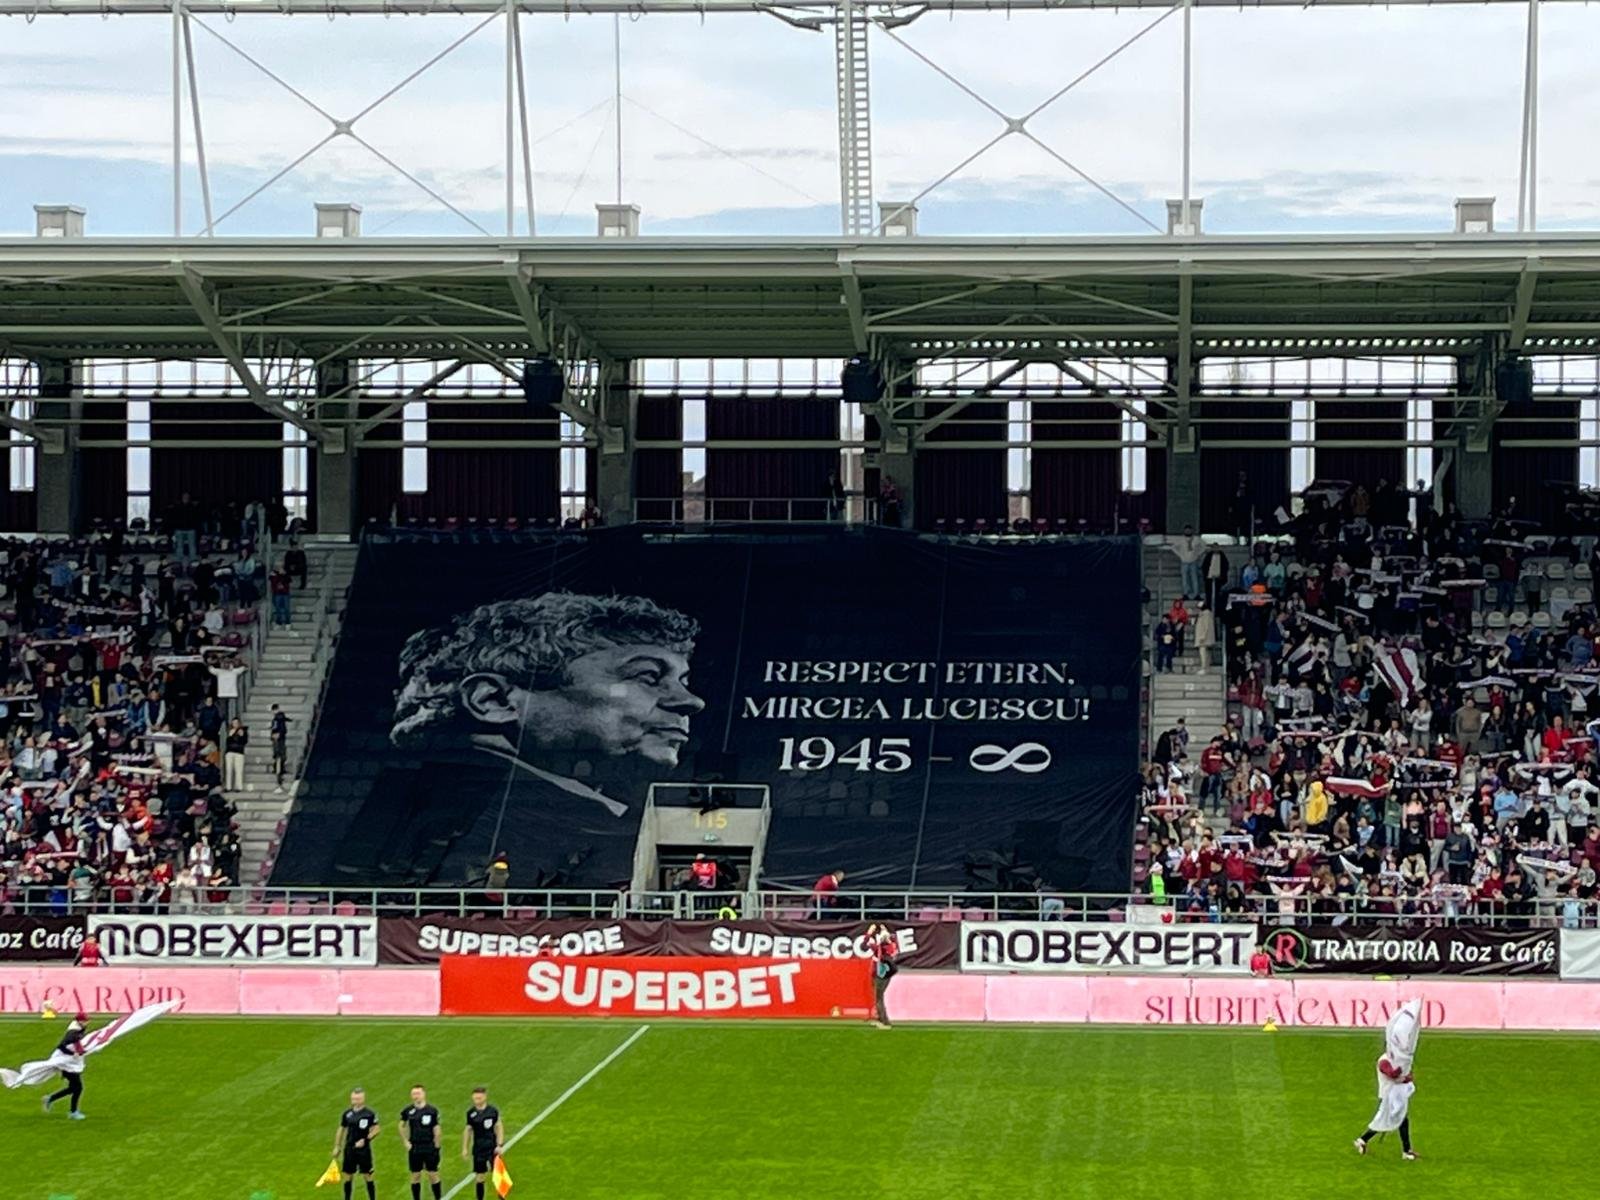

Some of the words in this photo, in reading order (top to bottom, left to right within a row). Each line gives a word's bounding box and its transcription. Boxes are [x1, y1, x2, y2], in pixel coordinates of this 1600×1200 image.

[764, 660, 936, 684] RESPECT
[945, 662, 1075, 686] ETERN.
[741, 696, 890, 720] MIRCEA
[901, 697, 1091, 721] LUCESCU!
[778, 736, 912, 773] 1945
[0, 932, 24, 949] oz
[30, 925, 84, 950] Café
[95, 923, 371, 958] MOBEXPERT
[709, 926, 918, 959] SUPERSCOE
[966, 929, 1254, 966] MOBEXPERT
[1310, 938, 1441, 963] TRATTORIA
[1449, 940, 1493, 963] Roz
[1500, 940, 1557, 964] Café
[524, 960, 804, 1012] SUPERBET
[1298, 998, 1339, 1025] CA
[1352, 999, 1446, 1026] RAD
